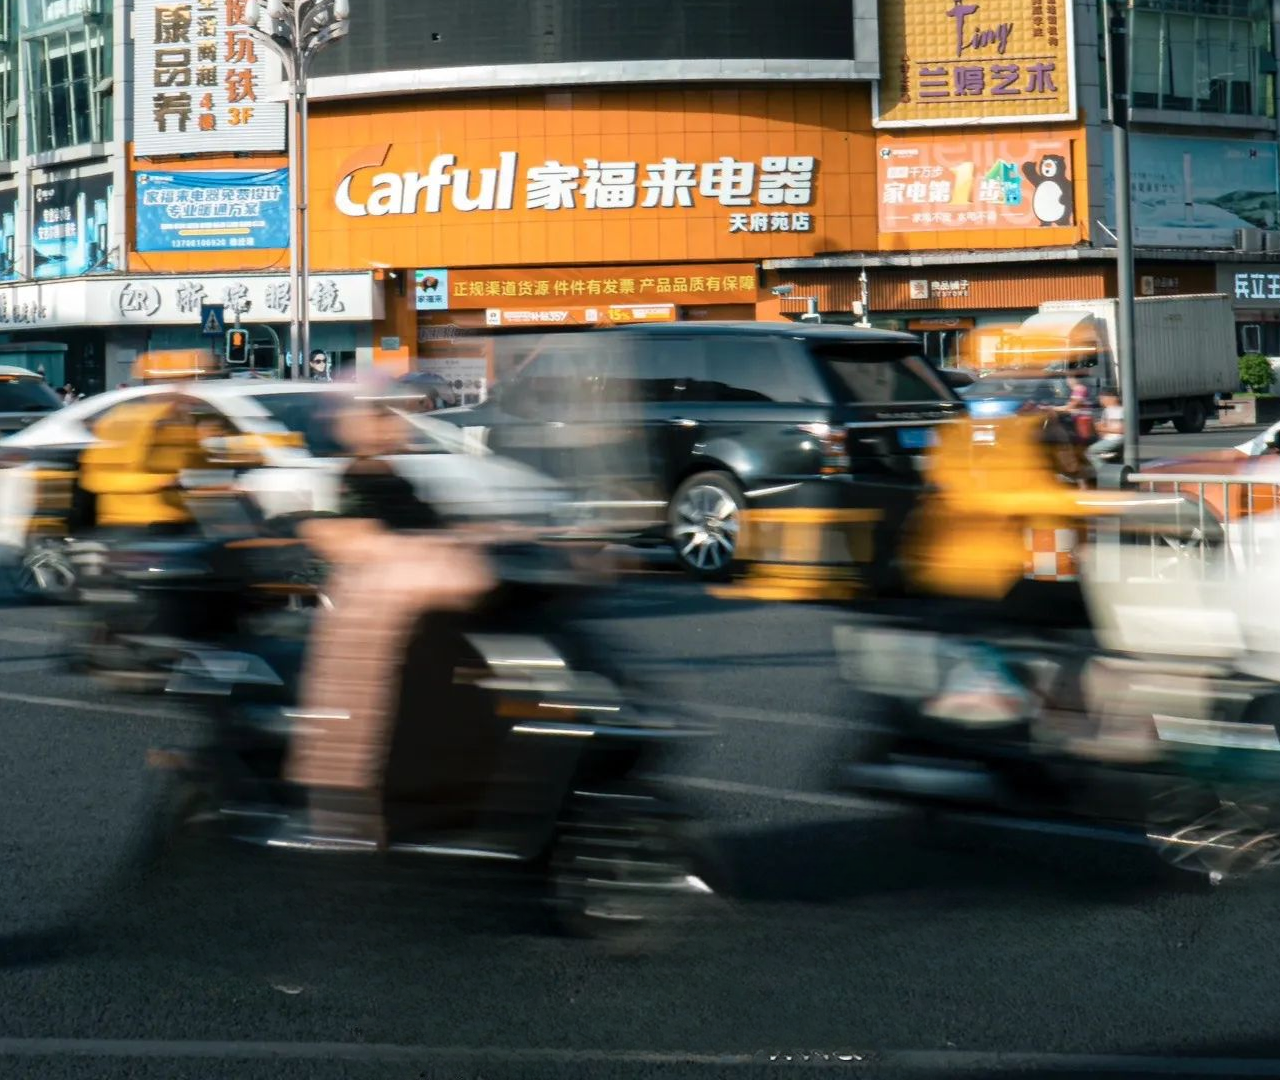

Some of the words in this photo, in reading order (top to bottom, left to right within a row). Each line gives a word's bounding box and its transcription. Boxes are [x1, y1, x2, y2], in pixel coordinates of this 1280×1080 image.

[228, 107, 254, 126] 3F
[334, 144, 518, 217] Carful
[526, 156, 815, 211] 家福来电器
[729, 212, 811, 233] 天府苑店
[453, 280, 550, 298] 正规渠道货源
[553, 277, 635, 296] 件件有发票
[639, 274, 756, 294] 产品品质有保障
